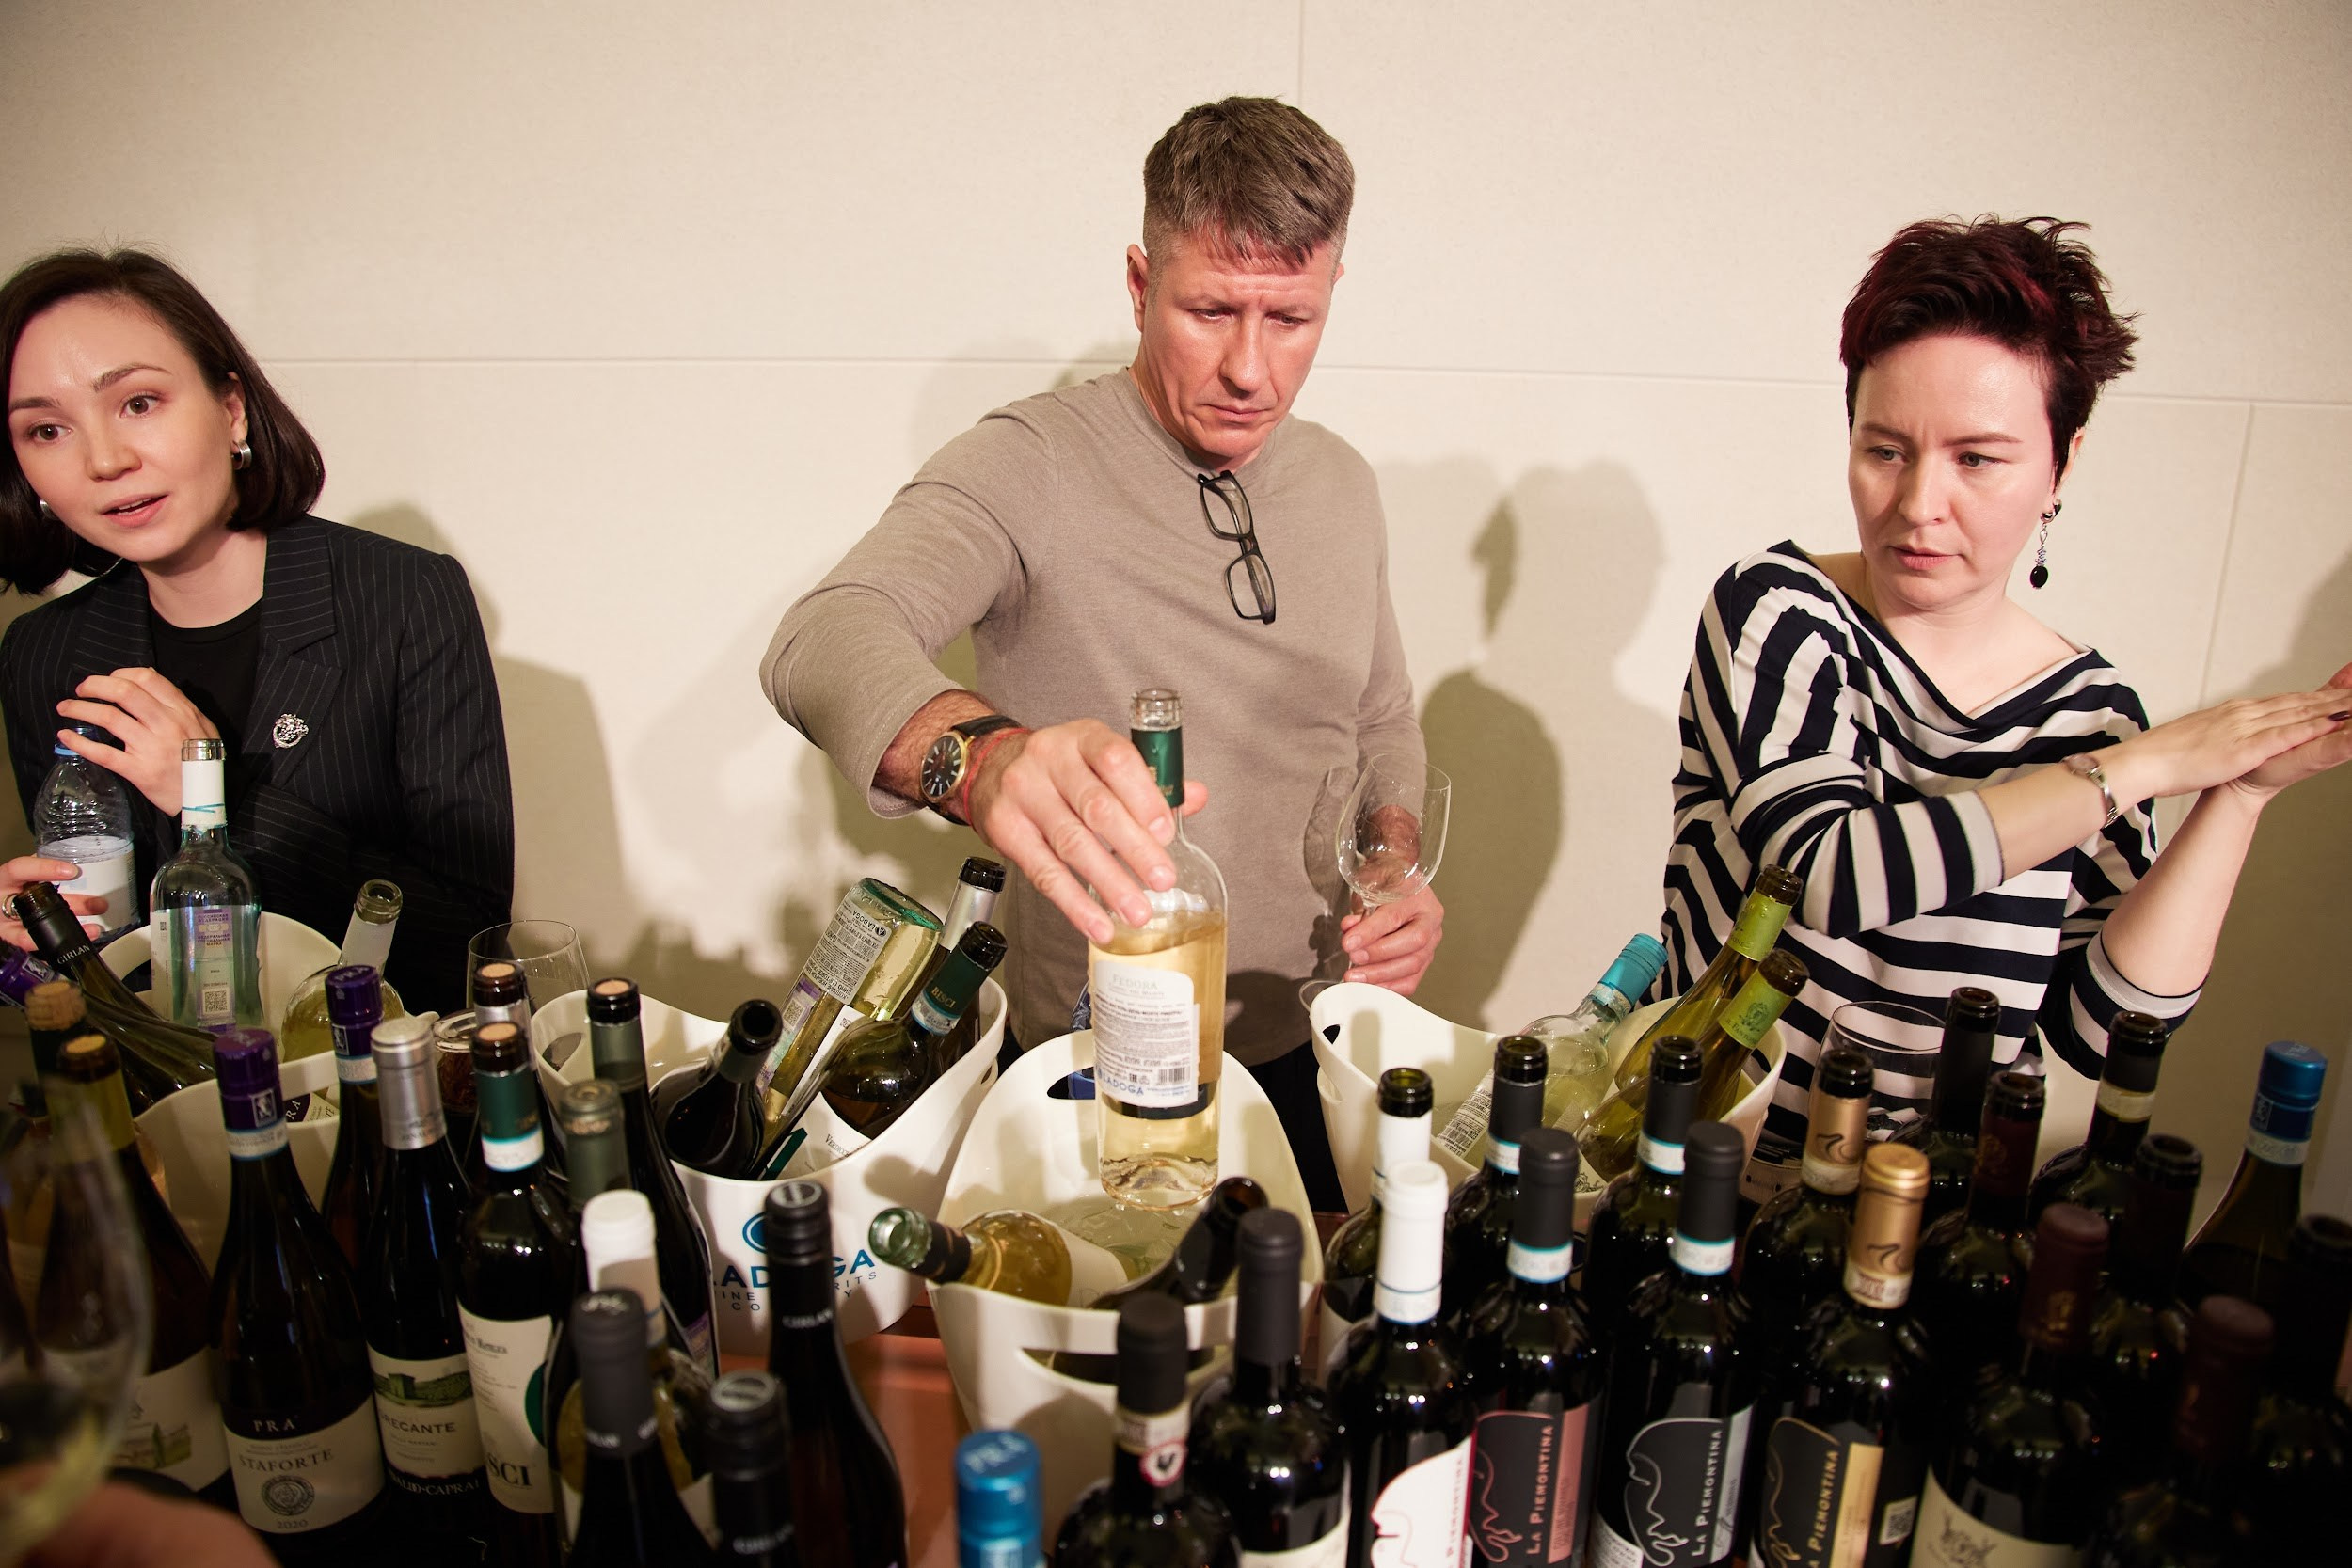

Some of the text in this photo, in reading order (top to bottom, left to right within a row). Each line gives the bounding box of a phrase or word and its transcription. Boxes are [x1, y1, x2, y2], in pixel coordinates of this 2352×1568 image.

[851, 910, 876, 931] LADOGA
[56, 943, 91, 965] GIRLAN
[1112, 973, 1159, 990] FEDORA
[931, 986, 956, 1008] BISCI
[1103, 1076, 1145, 1096] LADOGA
[285, 1099, 302, 1121] RA
[713, 1249, 876, 1289] ADGA
[715, 1291, 755, 1301] INE
[253, 1418, 296, 1433] PRA
[380, 1414, 457, 1434] RECANTE
[239, 1448, 334, 1472] STAFORTE
[485, 1451, 534, 1488] SCI
[1526, 1425, 1553, 1555] LA PIEMONTINA
[1691, 1429, 1723, 1557] LA PIEMONTINA
[1806, 1449, 1839, 1552] PIEMONTINA
[278, 1519, 309, 1529] 2020
